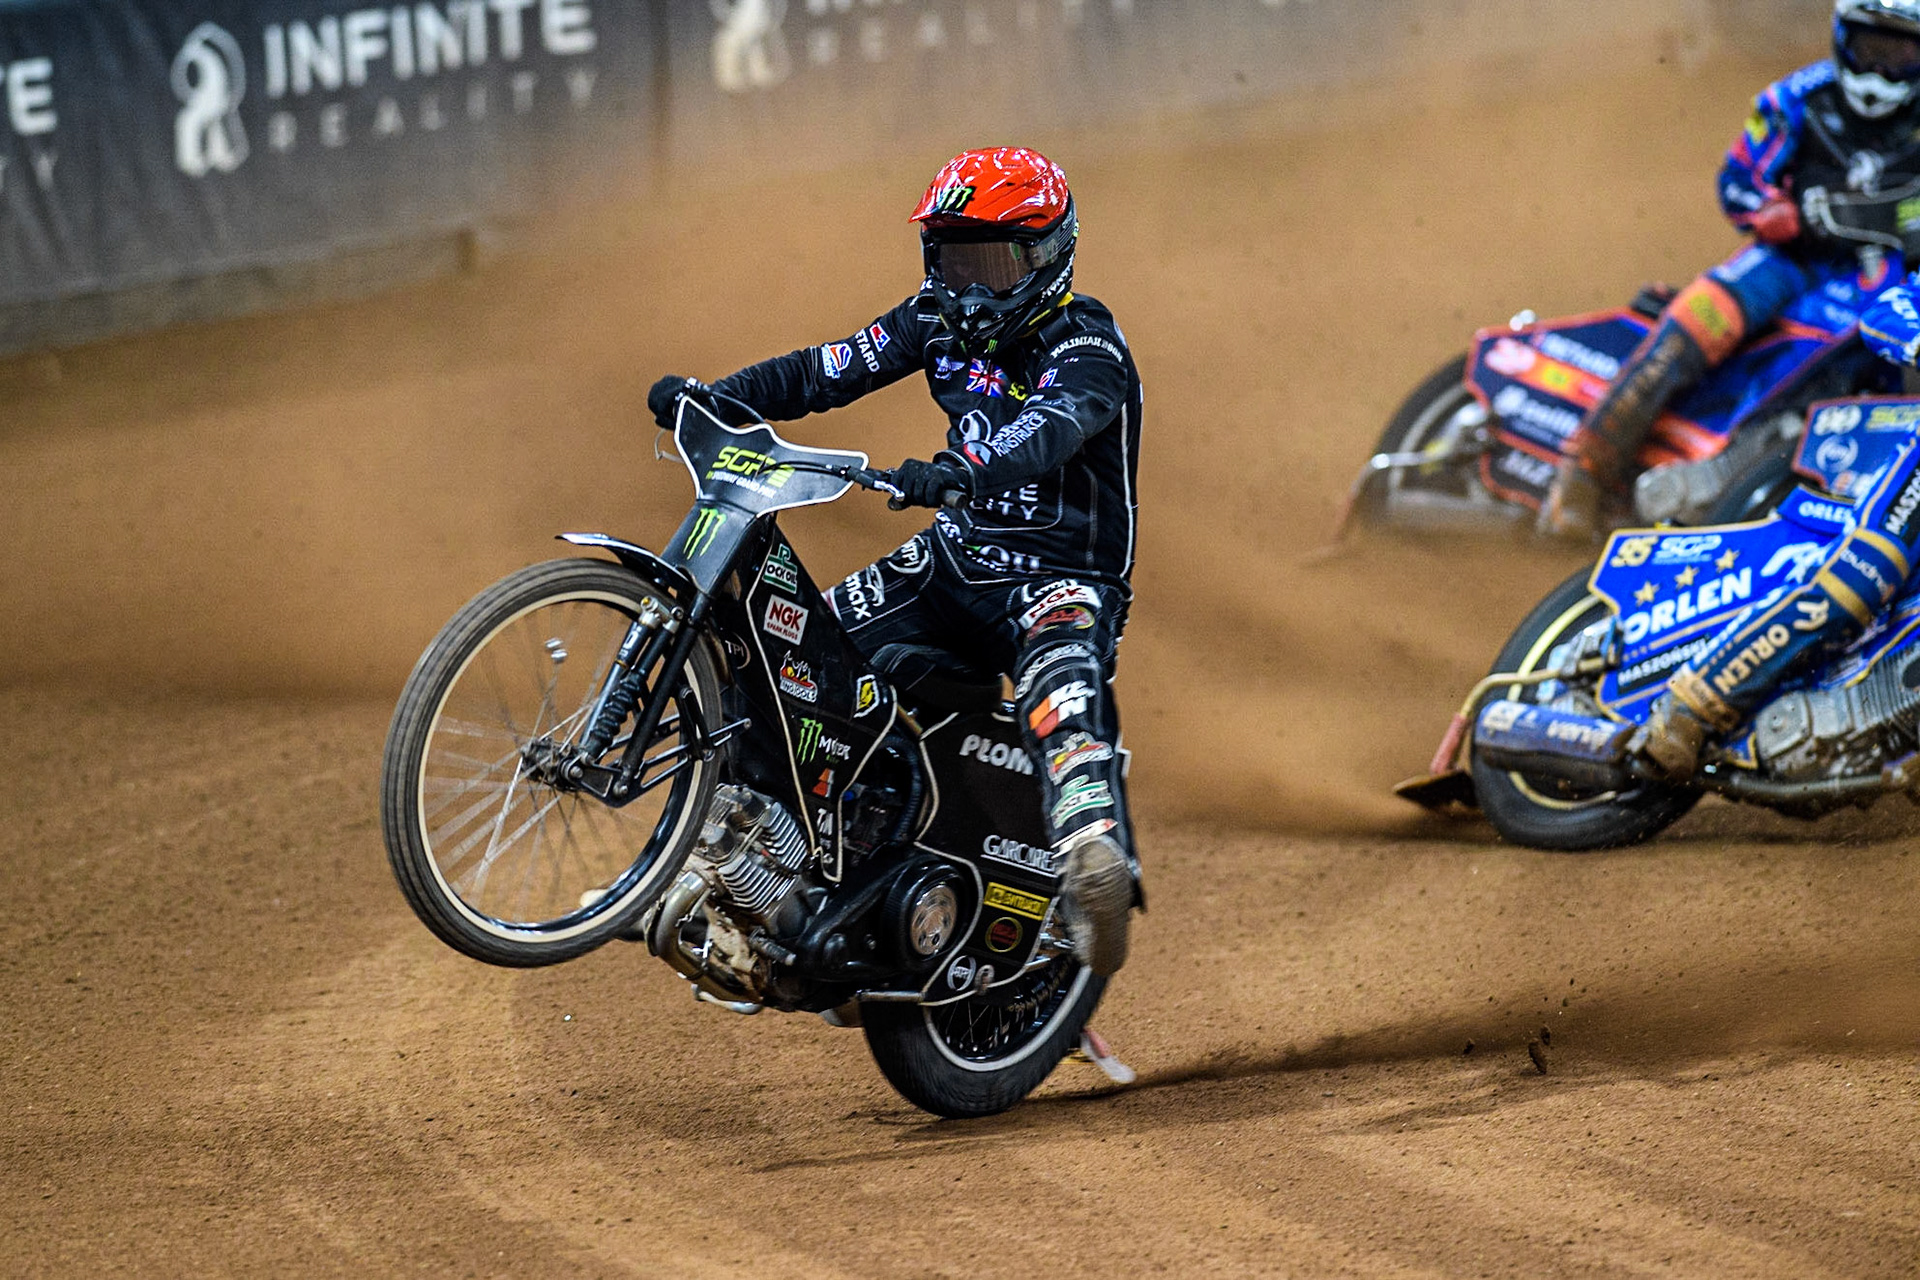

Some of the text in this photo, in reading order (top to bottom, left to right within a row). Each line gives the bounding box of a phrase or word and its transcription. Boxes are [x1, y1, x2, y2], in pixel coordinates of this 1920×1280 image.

[263, 0, 598, 99] INFINITE
[0, 56, 57, 136] E
[769, 600, 804, 632] NGK
[845, 571, 872, 620] max
[1623, 567, 1752, 645] ORLEN
[1713, 623, 1791, 695] ORLEN
